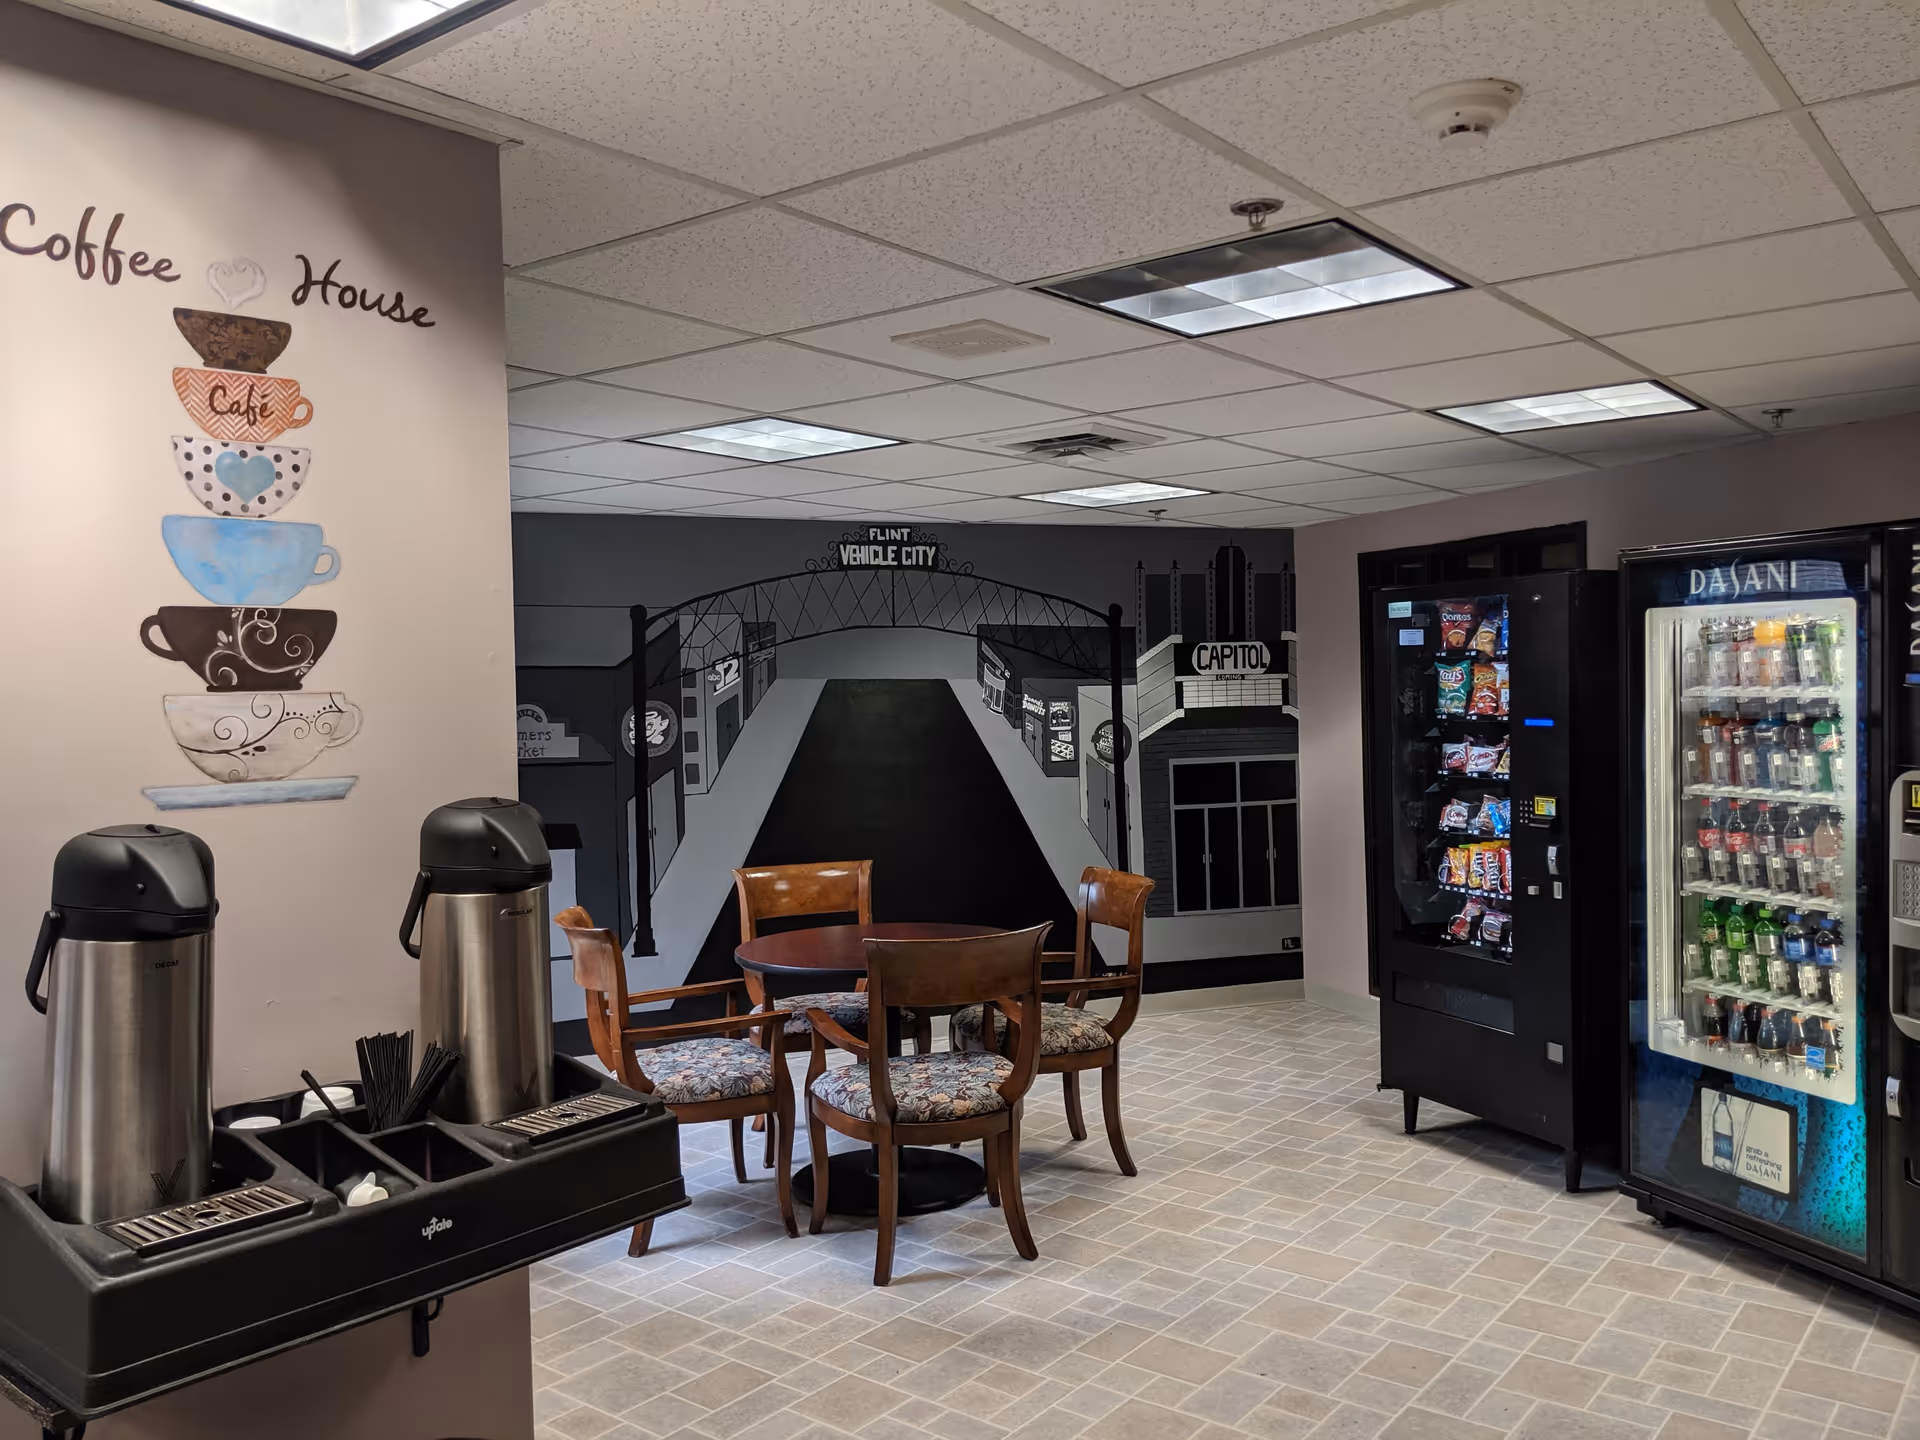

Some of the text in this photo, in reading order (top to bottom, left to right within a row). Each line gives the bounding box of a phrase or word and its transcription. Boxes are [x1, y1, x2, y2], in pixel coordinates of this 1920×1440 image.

[0, 203, 436, 327] Coffee House
[208, 383, 274, 427] Café
[869, 528, 911, 541] FLINT
[840, 544, 936, 566] VEHICLE CITY
[1690, 556, 1797, 599] DASANI
[1442, 613, 1472, 621] Doritos
[1197, 644, 1267, 670] CAPITOL
[707, 658, 739, 691] abc 12
[1745, 1145, 1763, 1156] grab
[1745, 1153, 1782, 1172] refreshing
[1745, 1161, 1780, 1182] DASANI
